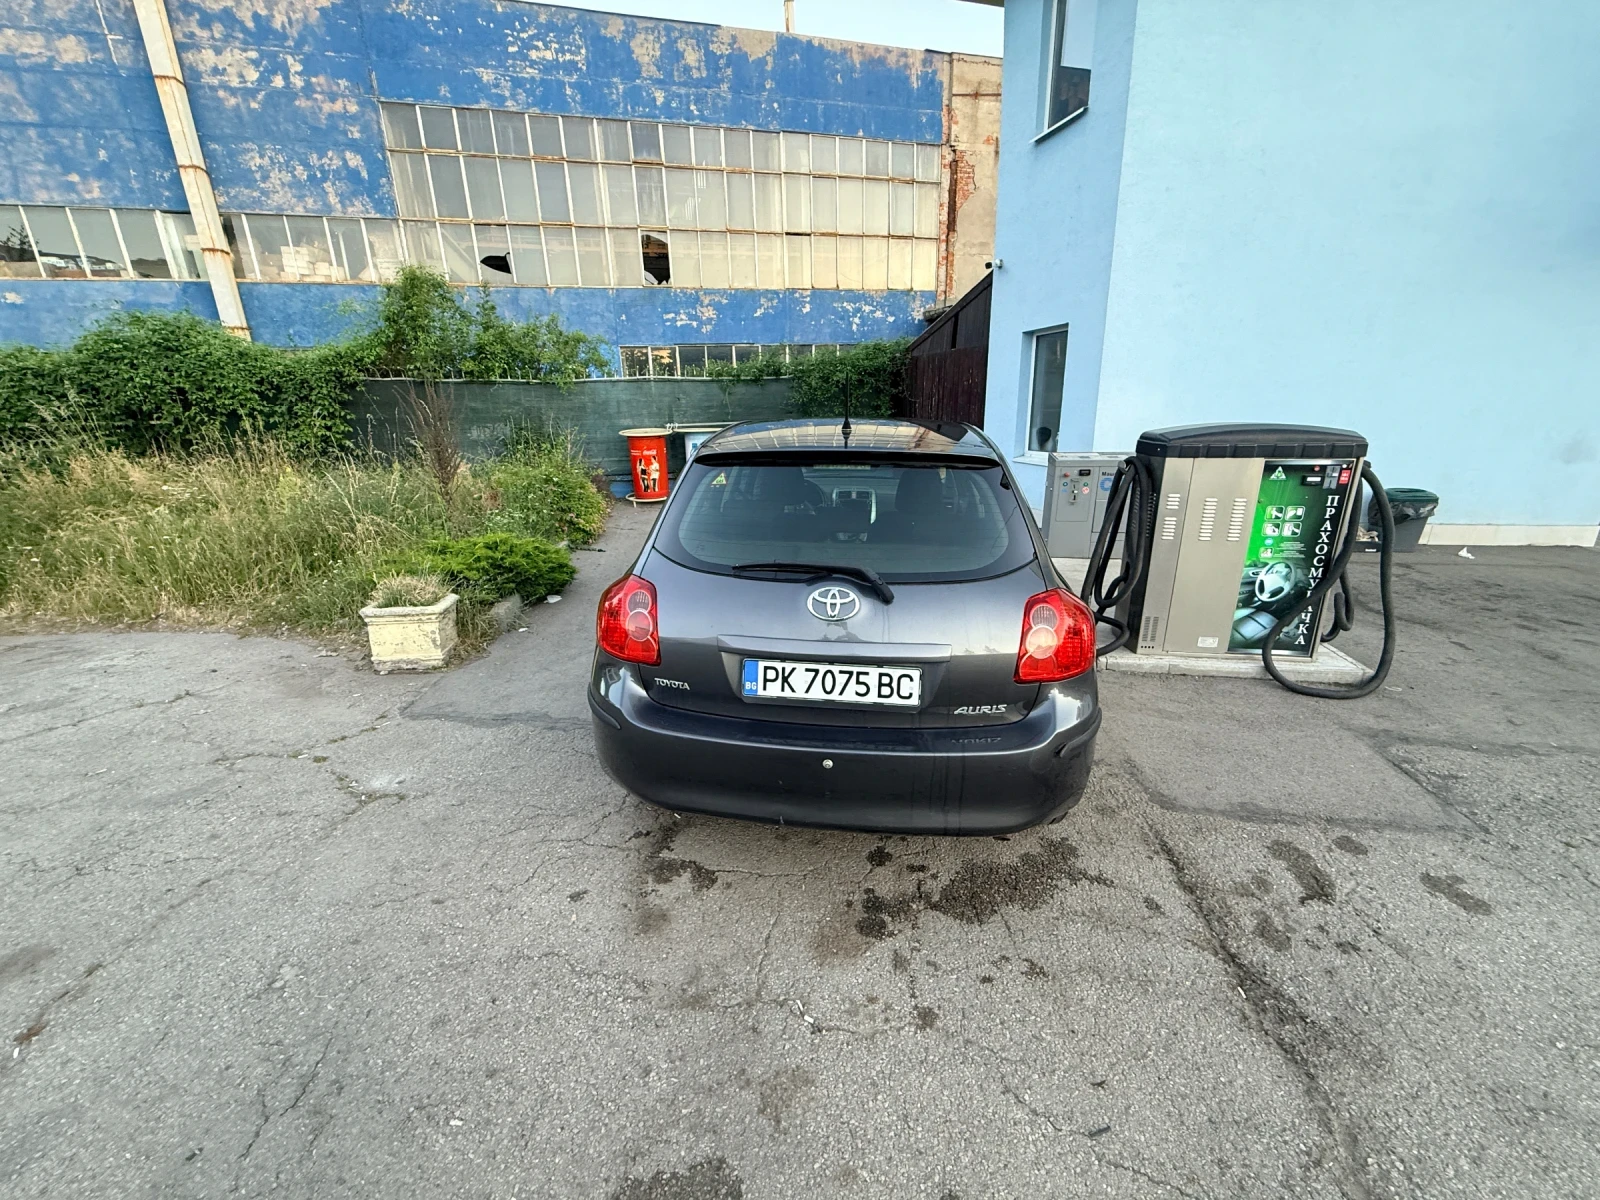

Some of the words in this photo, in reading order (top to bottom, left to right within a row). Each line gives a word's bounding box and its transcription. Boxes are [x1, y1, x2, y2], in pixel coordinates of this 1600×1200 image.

[1294, 495, 1340, 645] ПРАХОСМУЧКА
[654, 677, 690, 690] TOYOTA
[745, 681, 757, 690] BG
[762, 665, 797, 693] PK
[804, 667, 871, 698] 7075
[877, 672, 914, 700] BC
[953, 704, 1008, 715] AURIS
